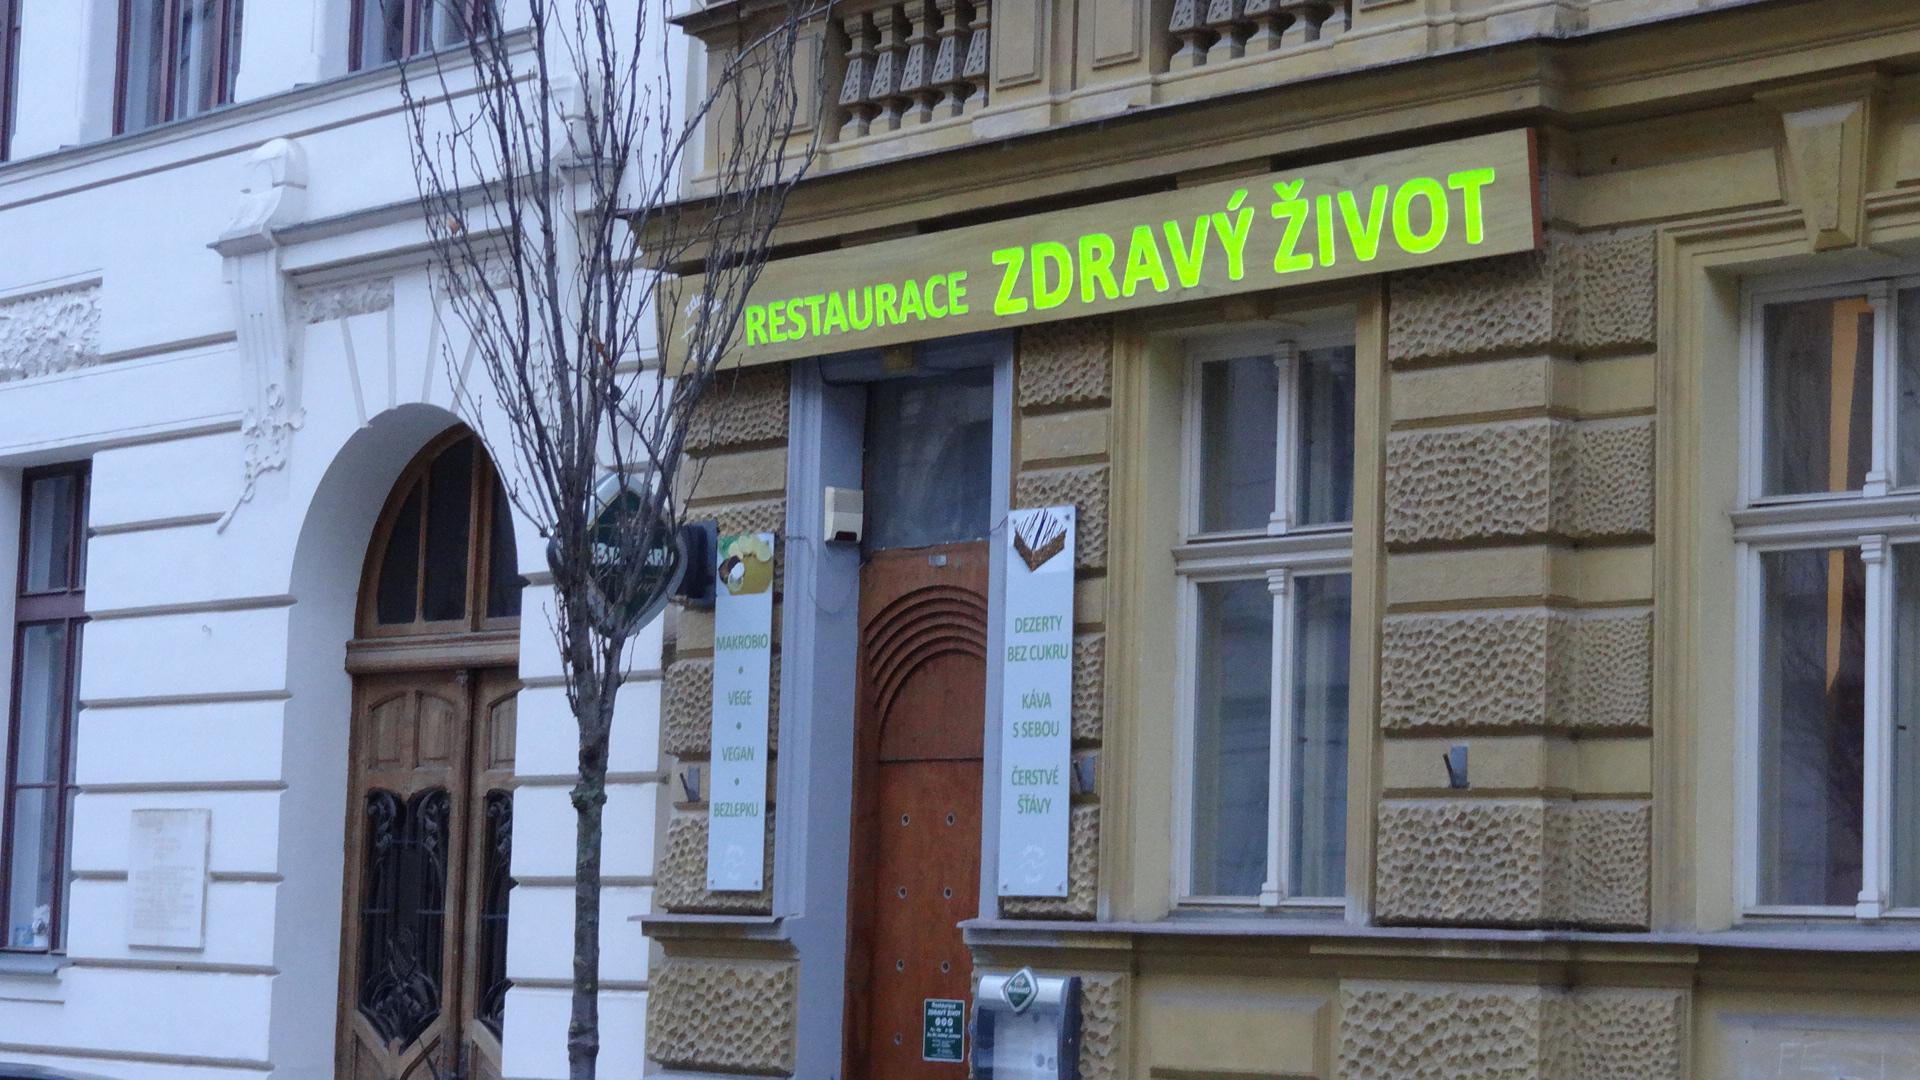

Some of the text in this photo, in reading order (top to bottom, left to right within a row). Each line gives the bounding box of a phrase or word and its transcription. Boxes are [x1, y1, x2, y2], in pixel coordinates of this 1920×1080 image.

[745, 167, 1496, 347] RESTAURACE ZDRAVÝ ŽIVOT
[1014, 615, 1063, 633] DEZERTY
[716, 633, 769, 651] MAKROBIO
[1007, 643, 1069, 662] BEZ CUKRU
[728, 690, 752, 706] VEGE
[1022, 688, 1052, 710] KÁVA
[1012, 720, 1060, 738] S SEBOU
[721, 746, 755, 761] VEGAN
[1011, 764, 1059, 786] ČERSTVÉ
[1017, 794, 1052, 814] ŠŤÁVY
